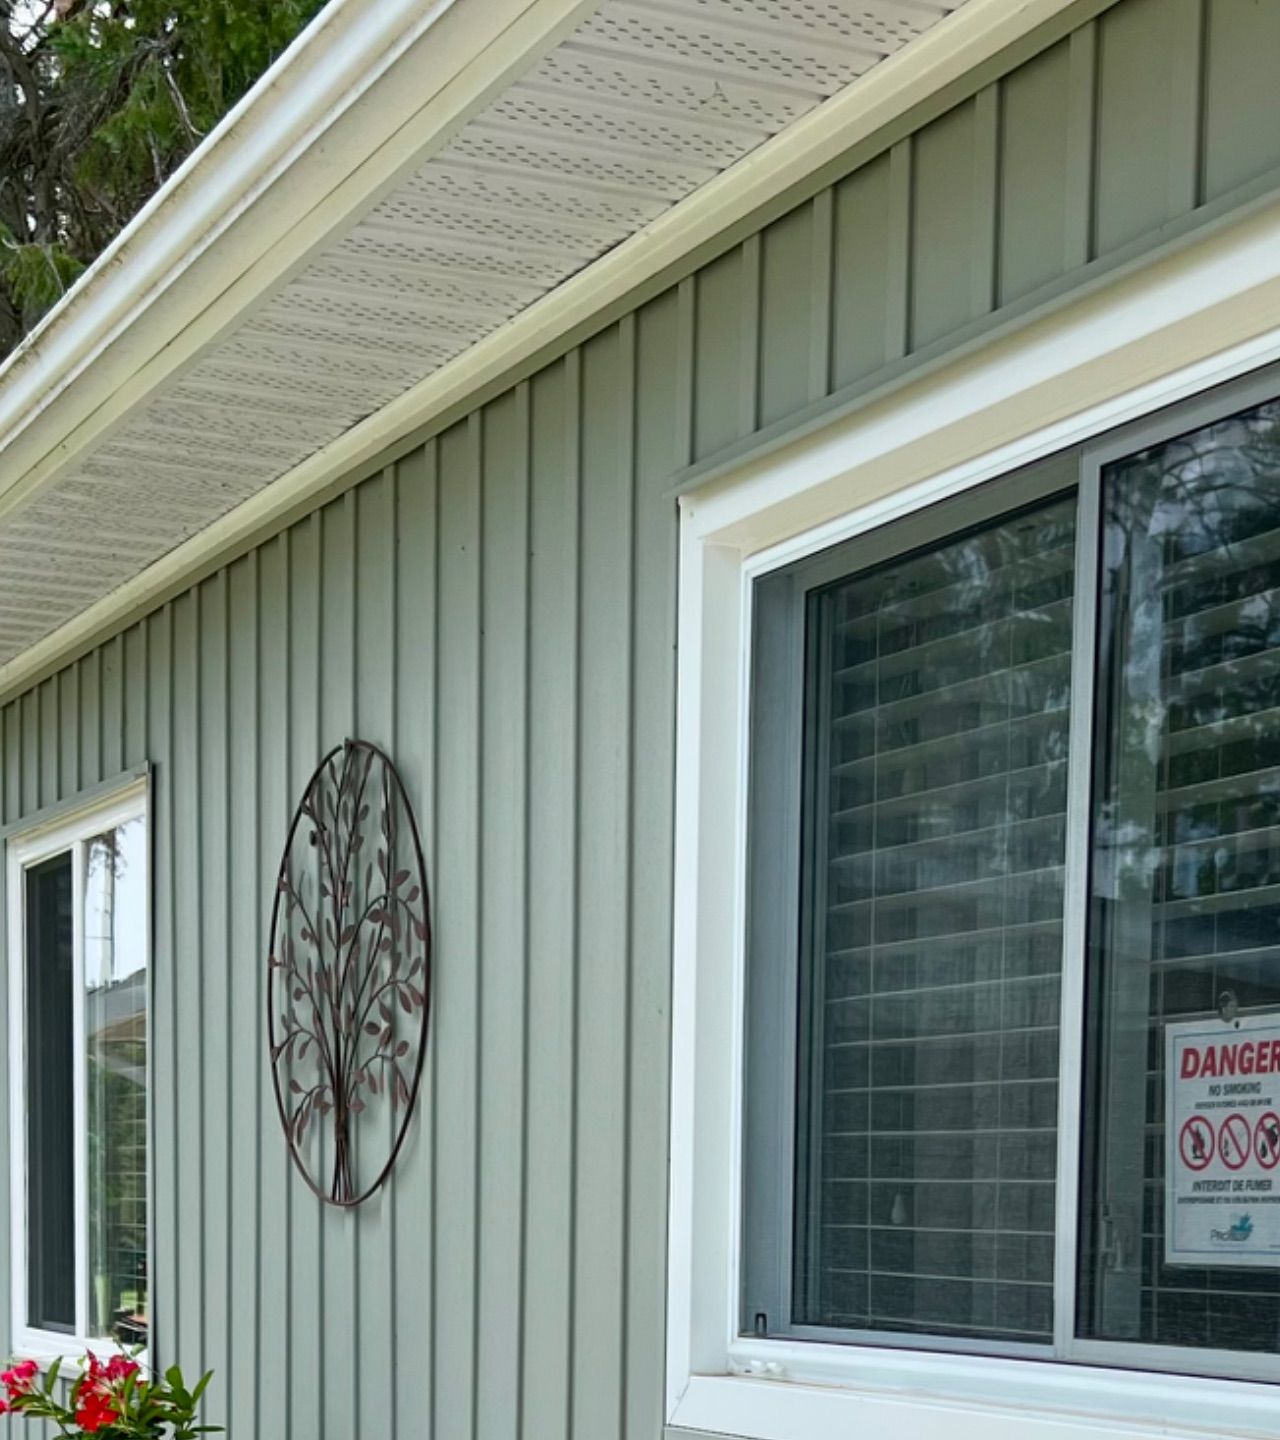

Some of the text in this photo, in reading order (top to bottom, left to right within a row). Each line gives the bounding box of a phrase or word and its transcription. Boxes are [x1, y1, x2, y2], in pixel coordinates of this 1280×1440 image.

[1208, 1081, 1262, 1097] NO SMOKING
[1192, 1178, 1272, 1192] INTERDIT DE FUMER
